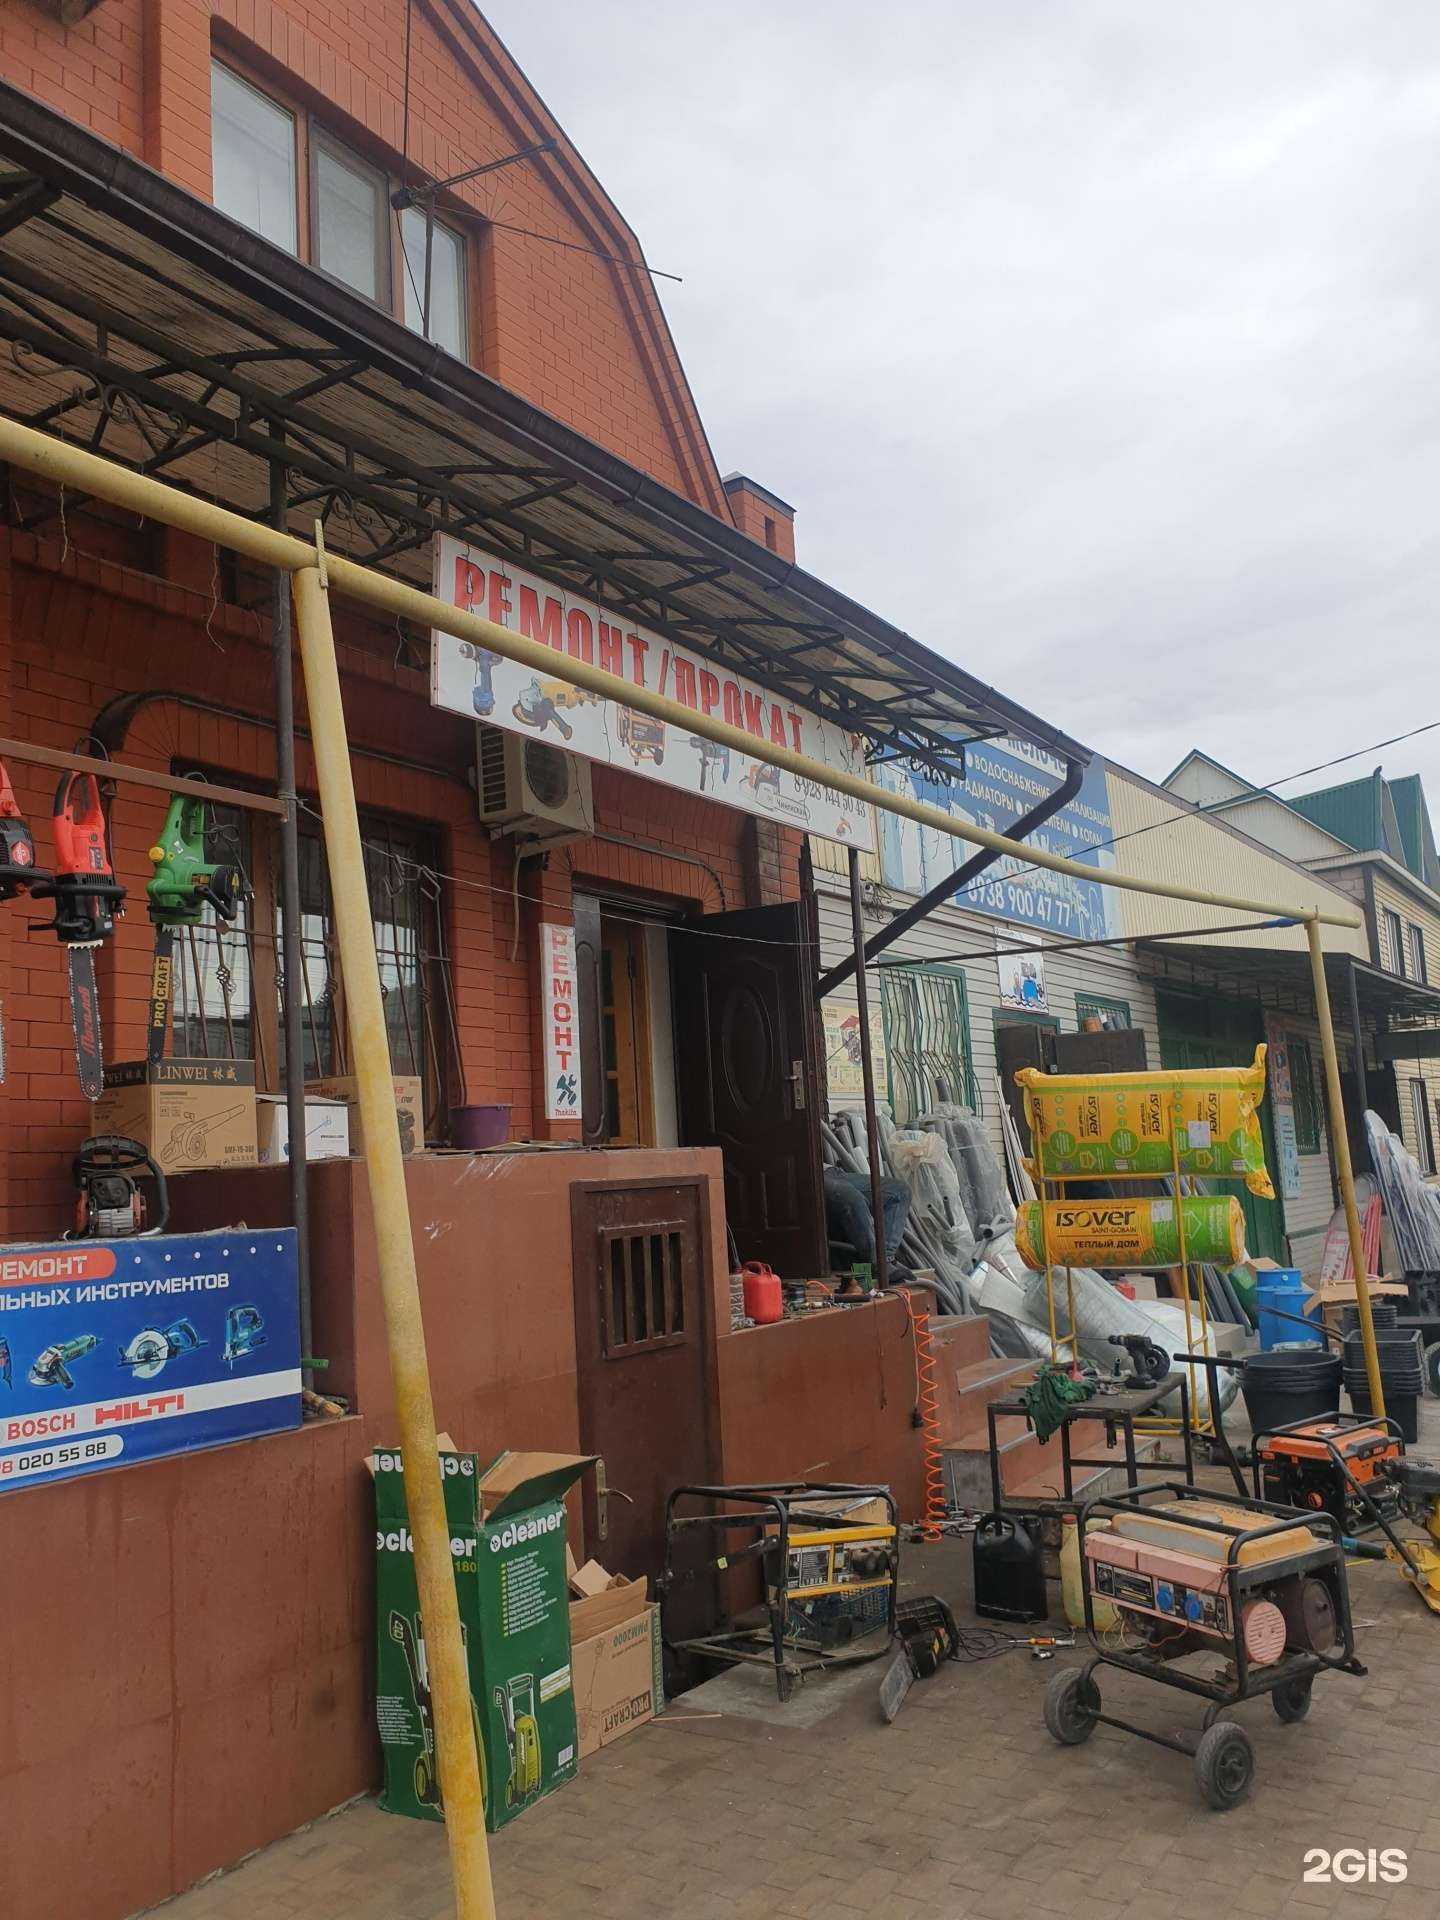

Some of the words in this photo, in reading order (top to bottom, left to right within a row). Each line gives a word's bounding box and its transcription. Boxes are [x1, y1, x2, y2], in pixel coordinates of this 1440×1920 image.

[1007, 885, 1034, 918] 900
[1037, 894, 1053, 922] 47
[1055, 900, 1071, 928] 77
[552, 927, 573, 1072] РЕМОНТ
[156, 1065, 208, 1081] LINWEI
[0, 1255, 88, 1280] ЕМОНТ
[76, 1273, 230, 1303] ИНСТРУМЕНТОВ
[8, 1412, 75, 1440] BOSCH
[95, 1394, 184, 1425] HILTI
[19, 1452, 53, 1470] 020
[59, 1447, 80, 1463] 55
[85, 1442, 106, 1457] 88
